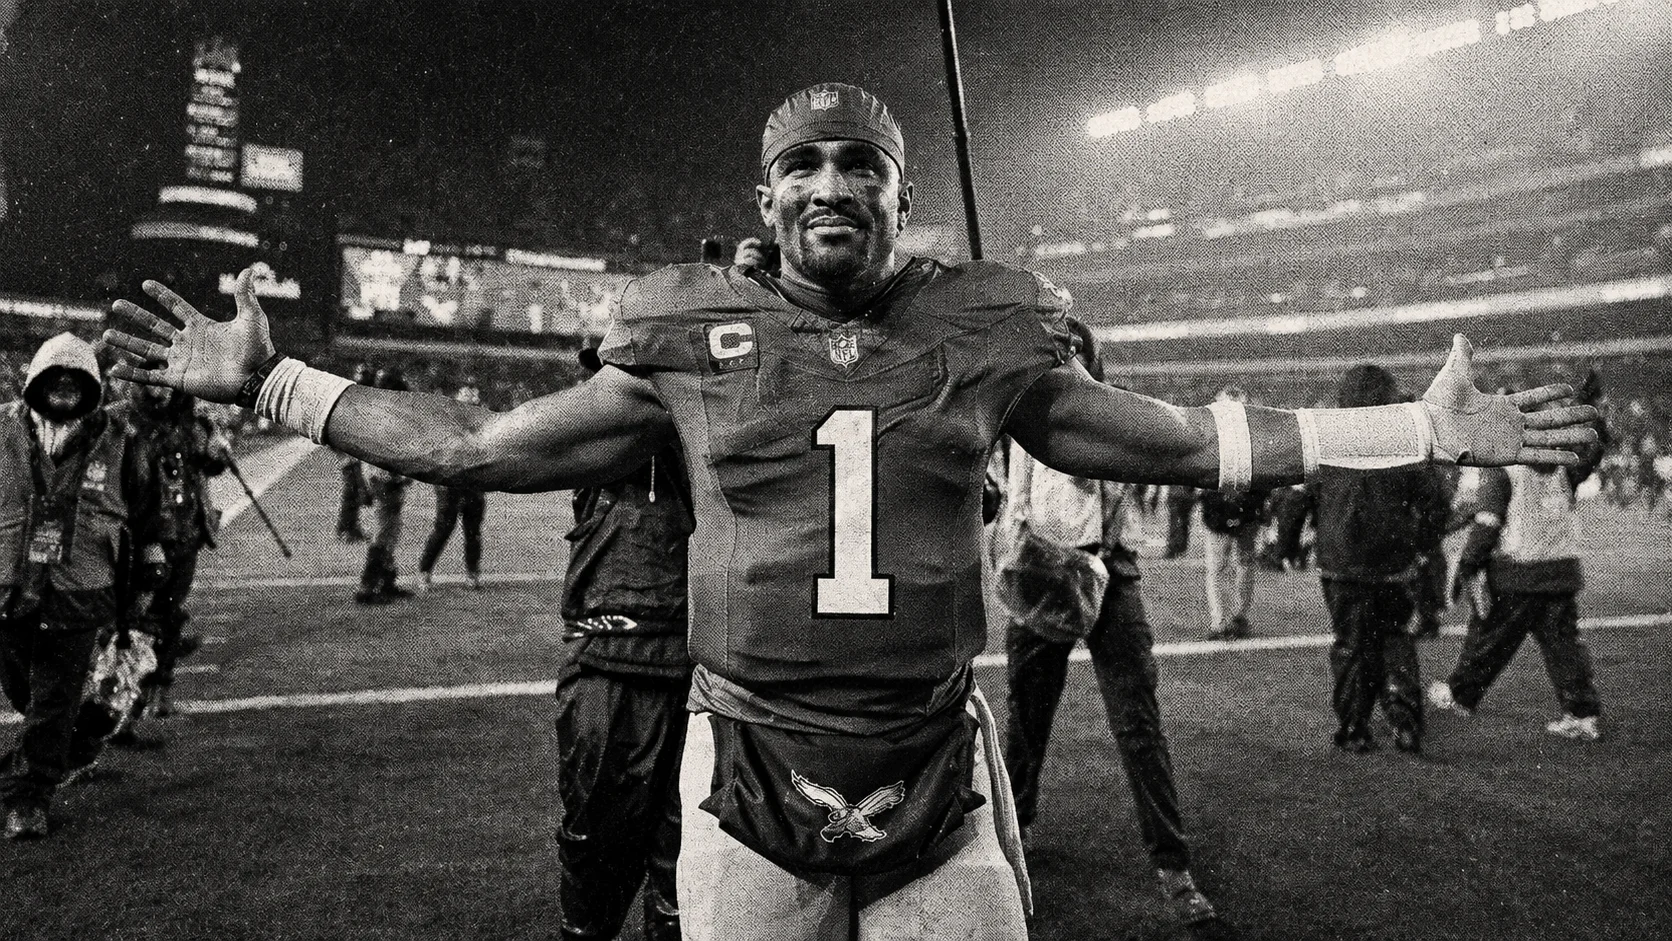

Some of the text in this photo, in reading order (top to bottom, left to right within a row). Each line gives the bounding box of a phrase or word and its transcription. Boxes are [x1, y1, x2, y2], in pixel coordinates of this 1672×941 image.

[709, 323, 753, 359] C
[831, 347, 857, 362] NFL
[812, 406, 894, 618] 1
